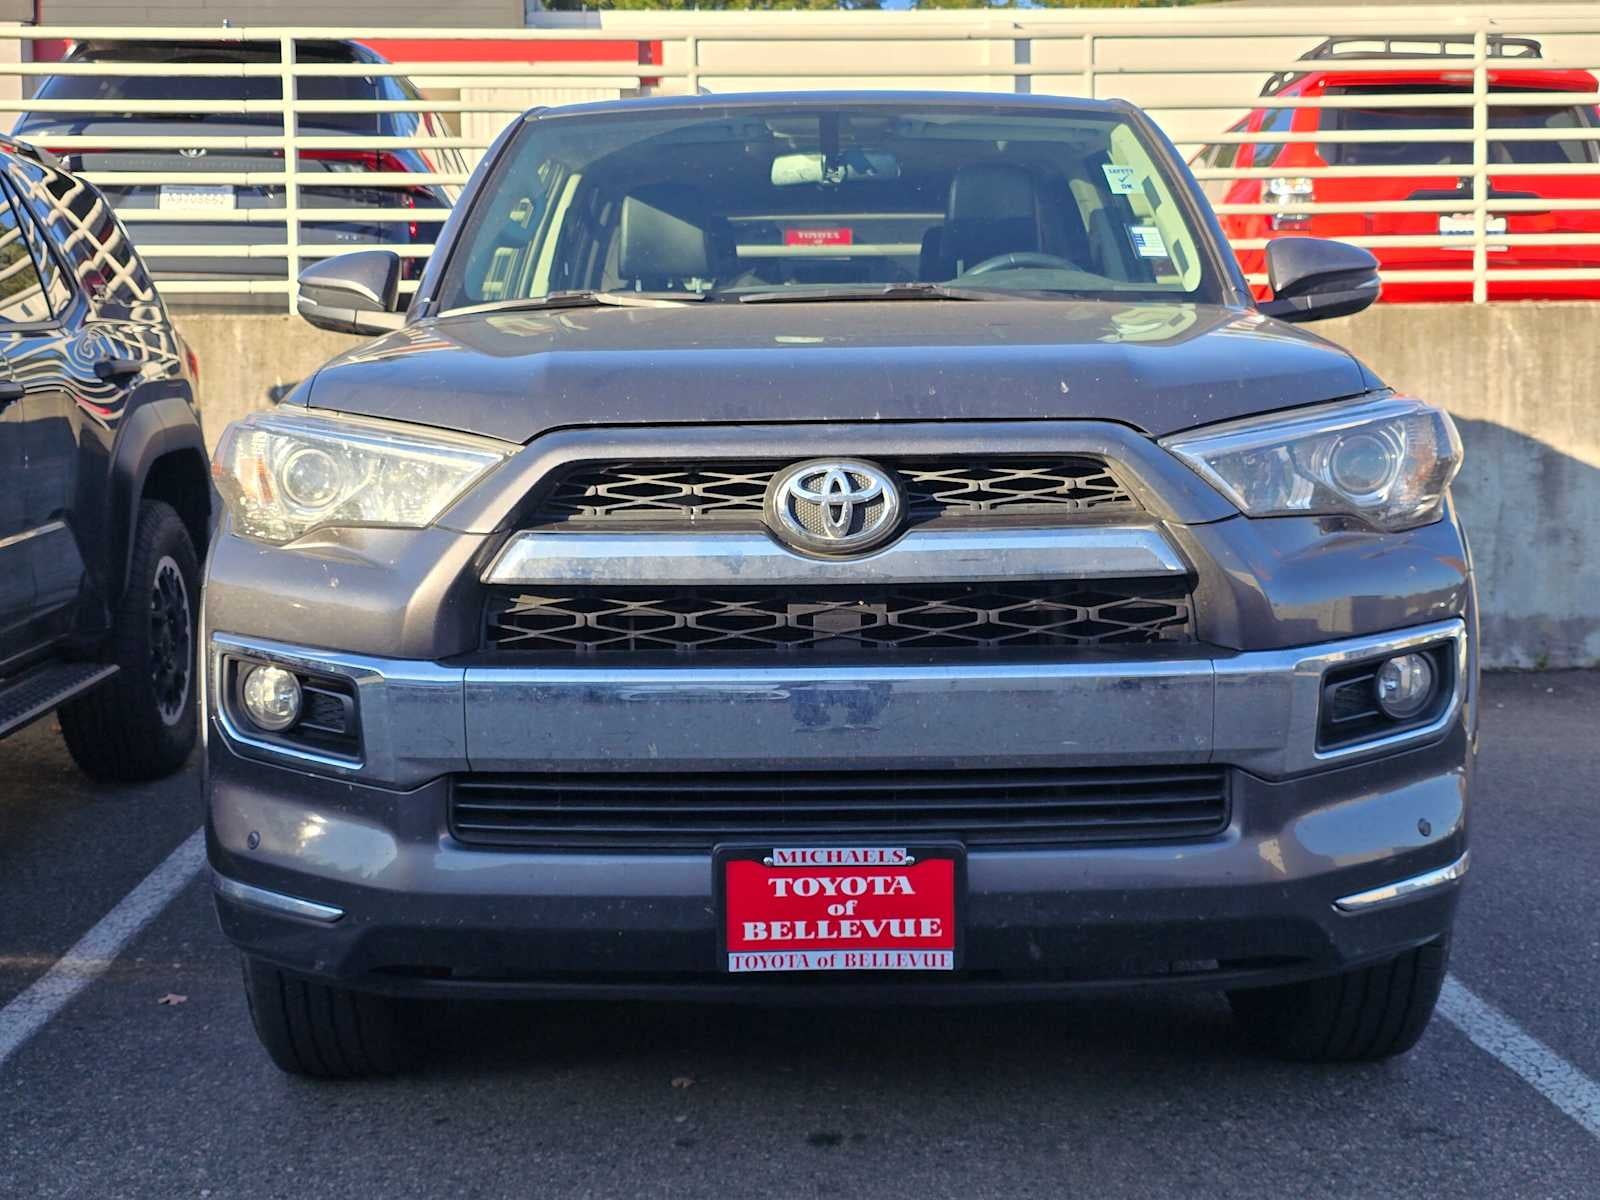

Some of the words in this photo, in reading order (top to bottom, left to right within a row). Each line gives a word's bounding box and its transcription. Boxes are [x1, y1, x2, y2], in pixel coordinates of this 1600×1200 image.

[776, 848, 906, 864] MICHAELS
[768, 875, 916, 897] TOYOTA
[827, 900, 858, 916] of
[742, 918, 943, 941] BELLEVUE
[733, 953, 811, 970] TOYOTA
[817, 953, 837, 968] of
[844, 952, 951, 969] BELLEVUE
